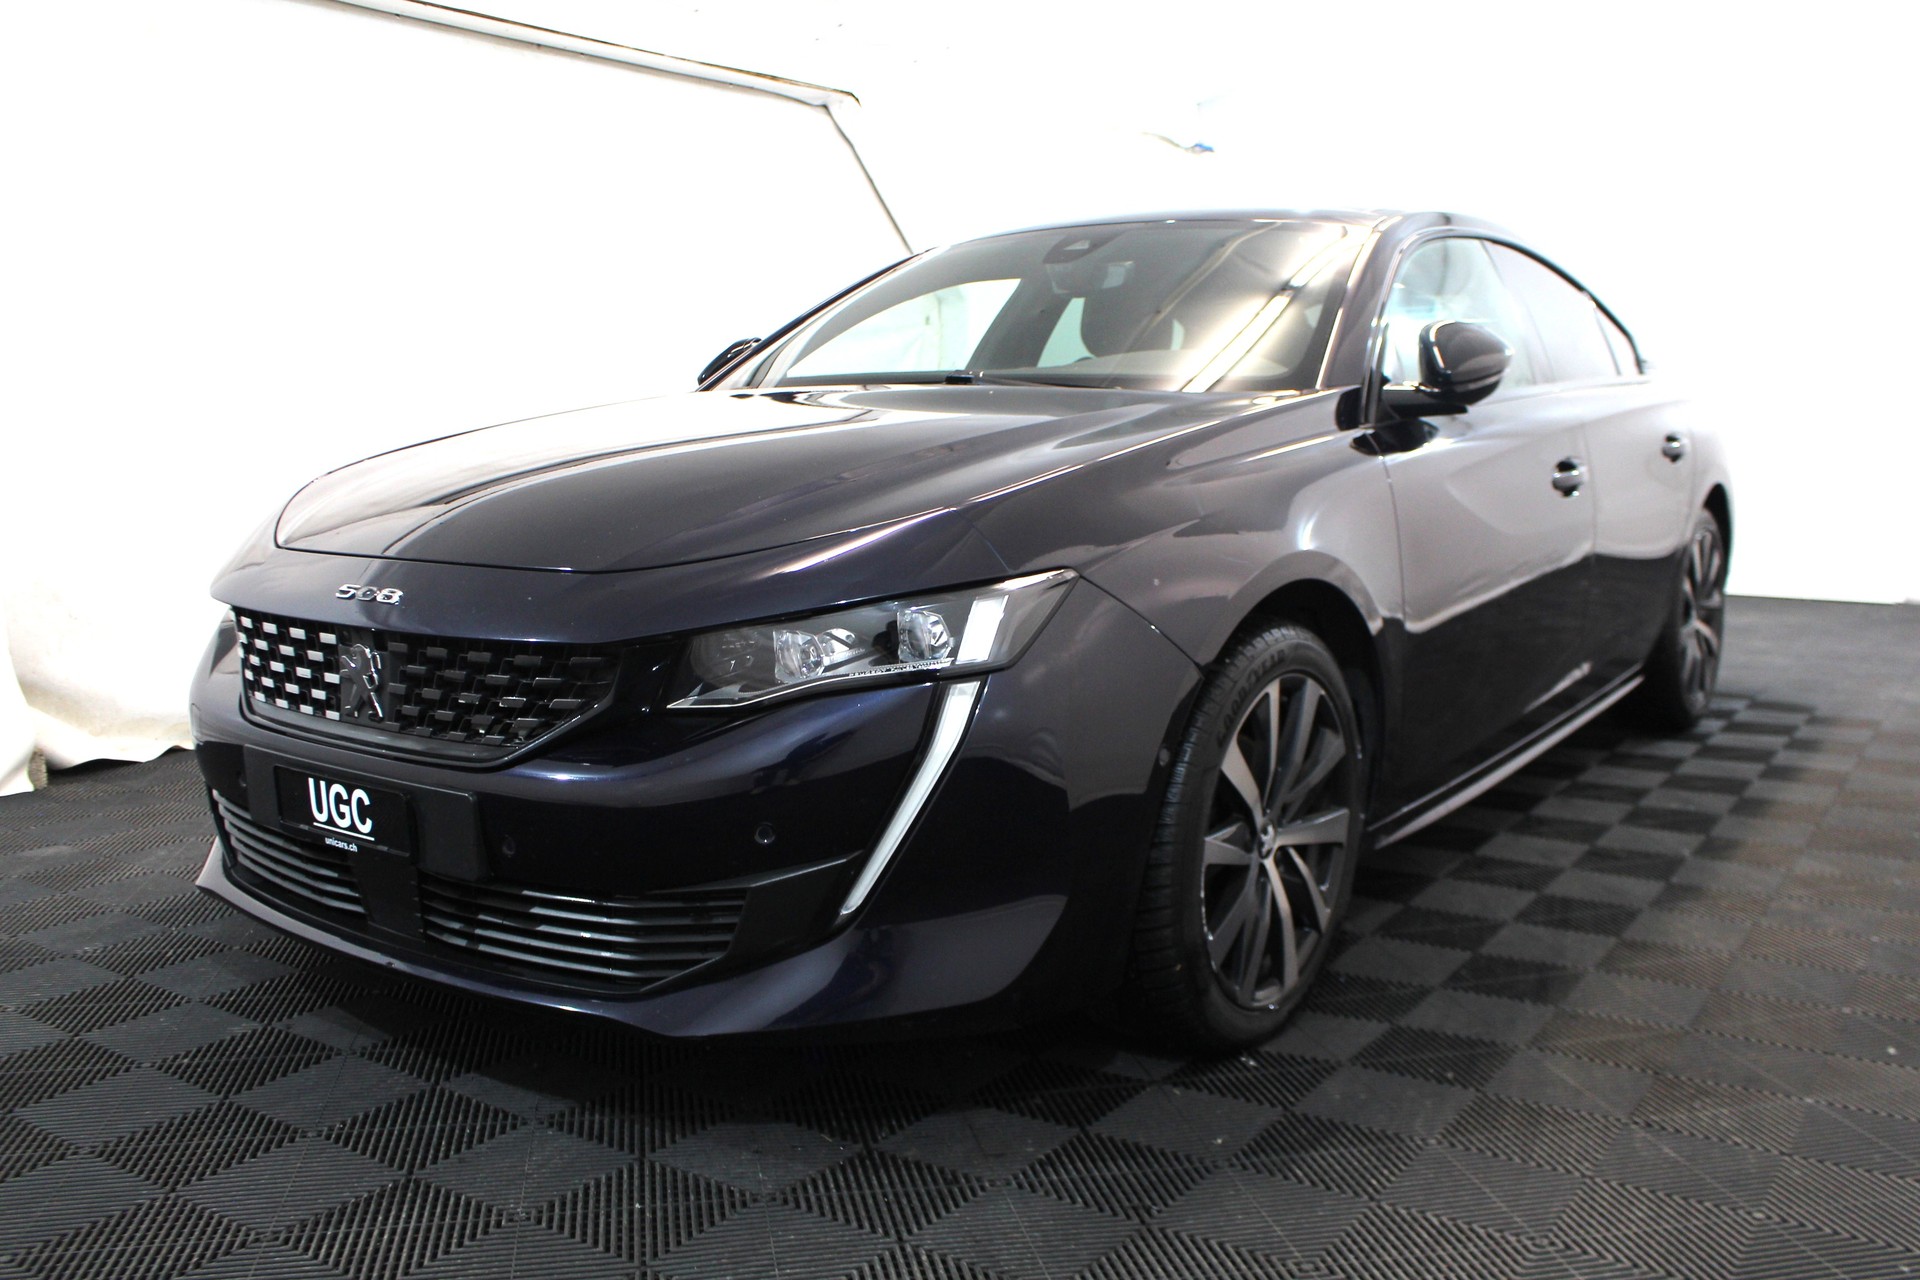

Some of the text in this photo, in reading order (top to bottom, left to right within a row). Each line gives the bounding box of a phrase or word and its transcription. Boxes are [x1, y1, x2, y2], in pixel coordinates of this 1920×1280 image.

[335, 583, 404, 606] 508
[308, 777, 373, 834] UGC
[324, 837, 358, 853] unicars.ch
